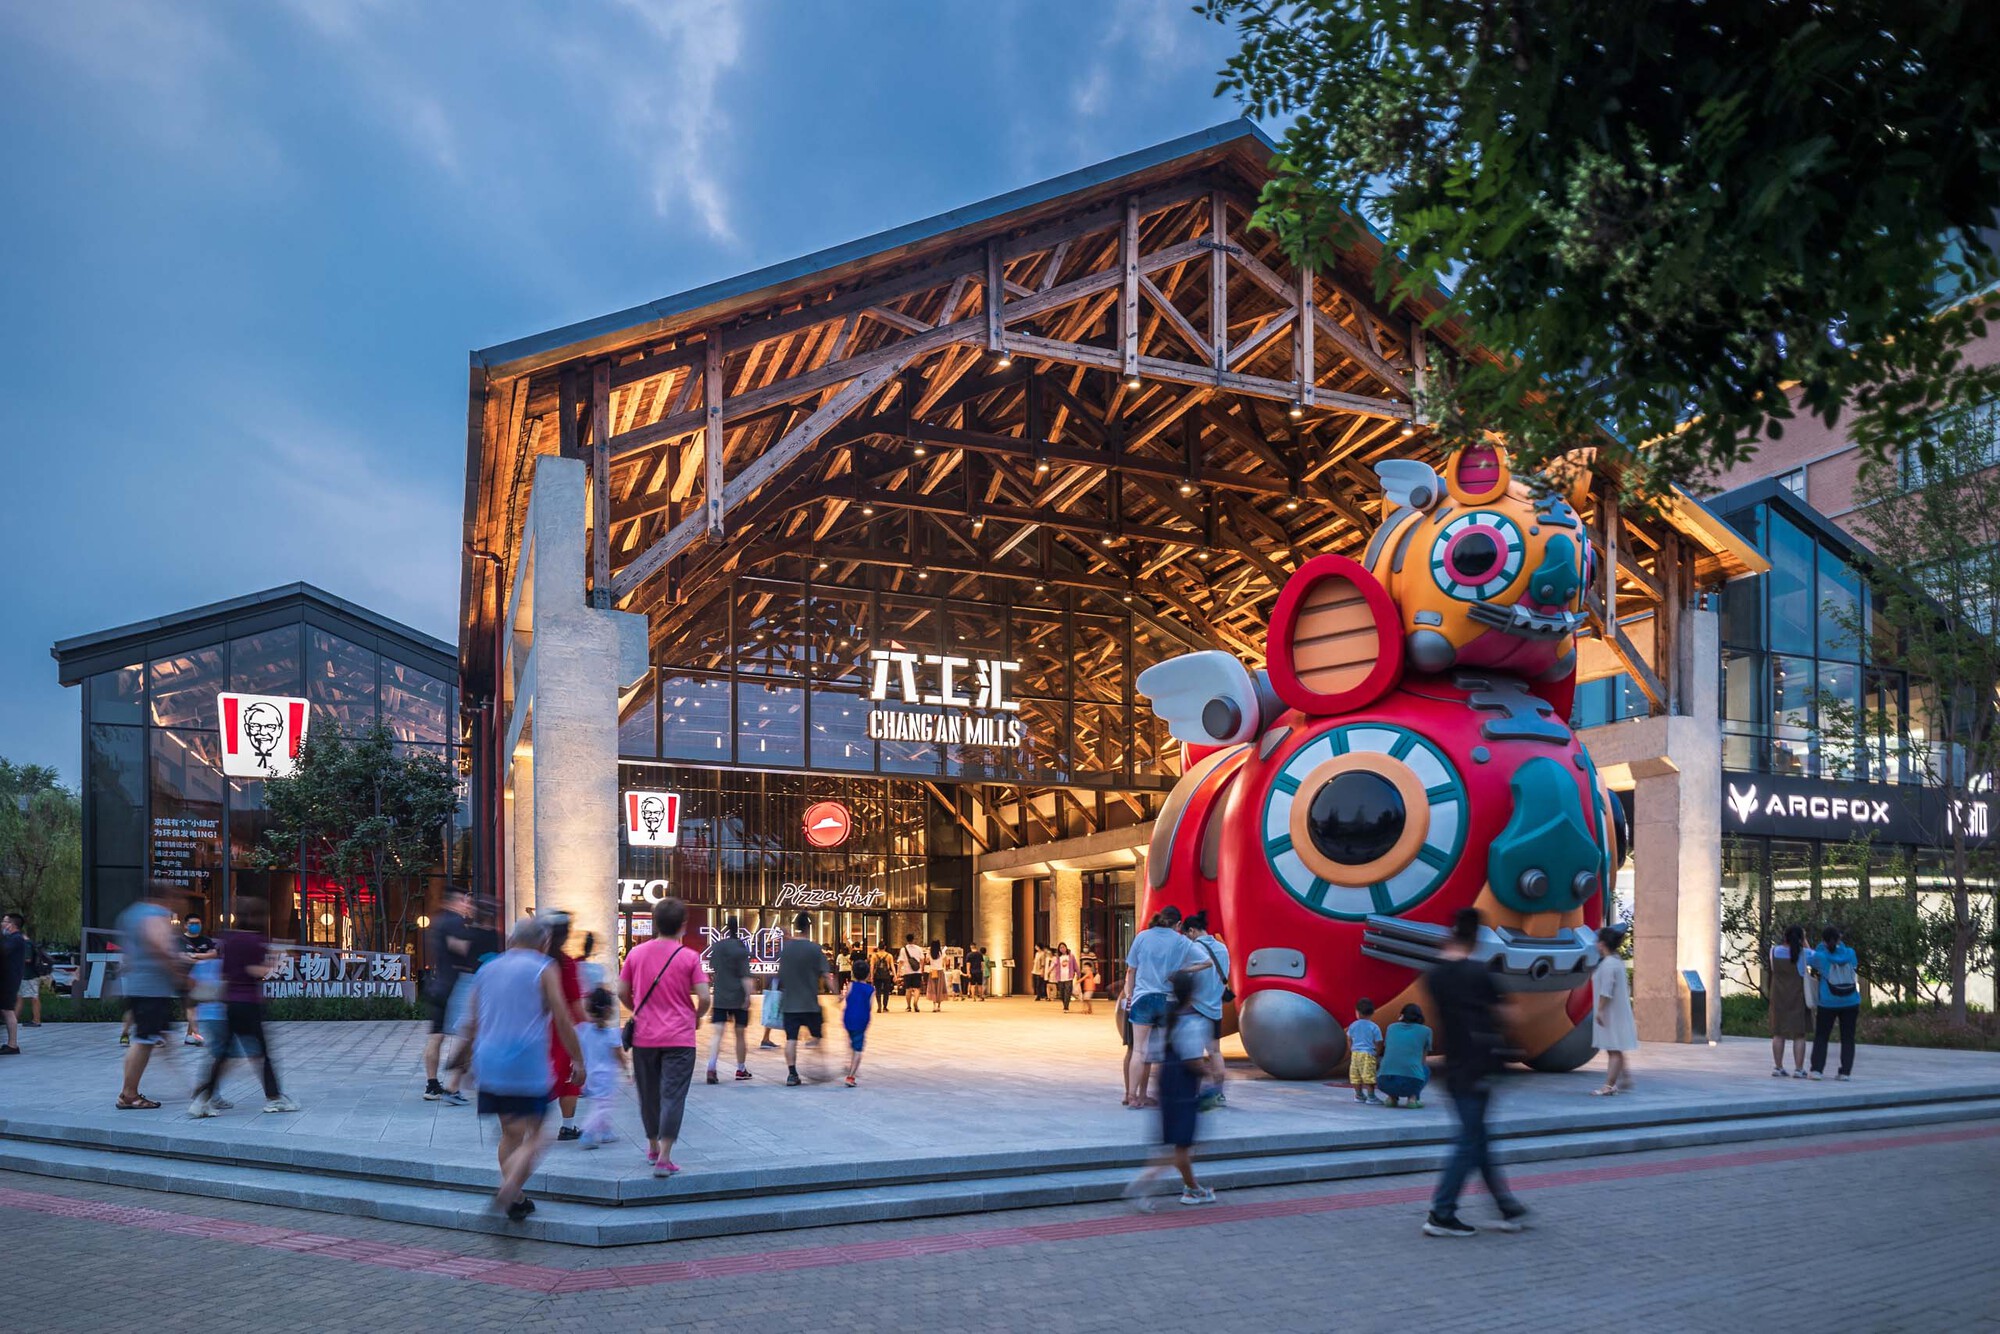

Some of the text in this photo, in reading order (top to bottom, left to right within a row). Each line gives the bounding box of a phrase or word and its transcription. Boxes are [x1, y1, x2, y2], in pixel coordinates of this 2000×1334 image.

[870, 710, 1020, 747] CHANG'AN MILLS
[1765, 794, 1890, 824] ARCFOX
[617, 879, 669, 905] FC
[775, 883, 885, 907] Pizza Hut
